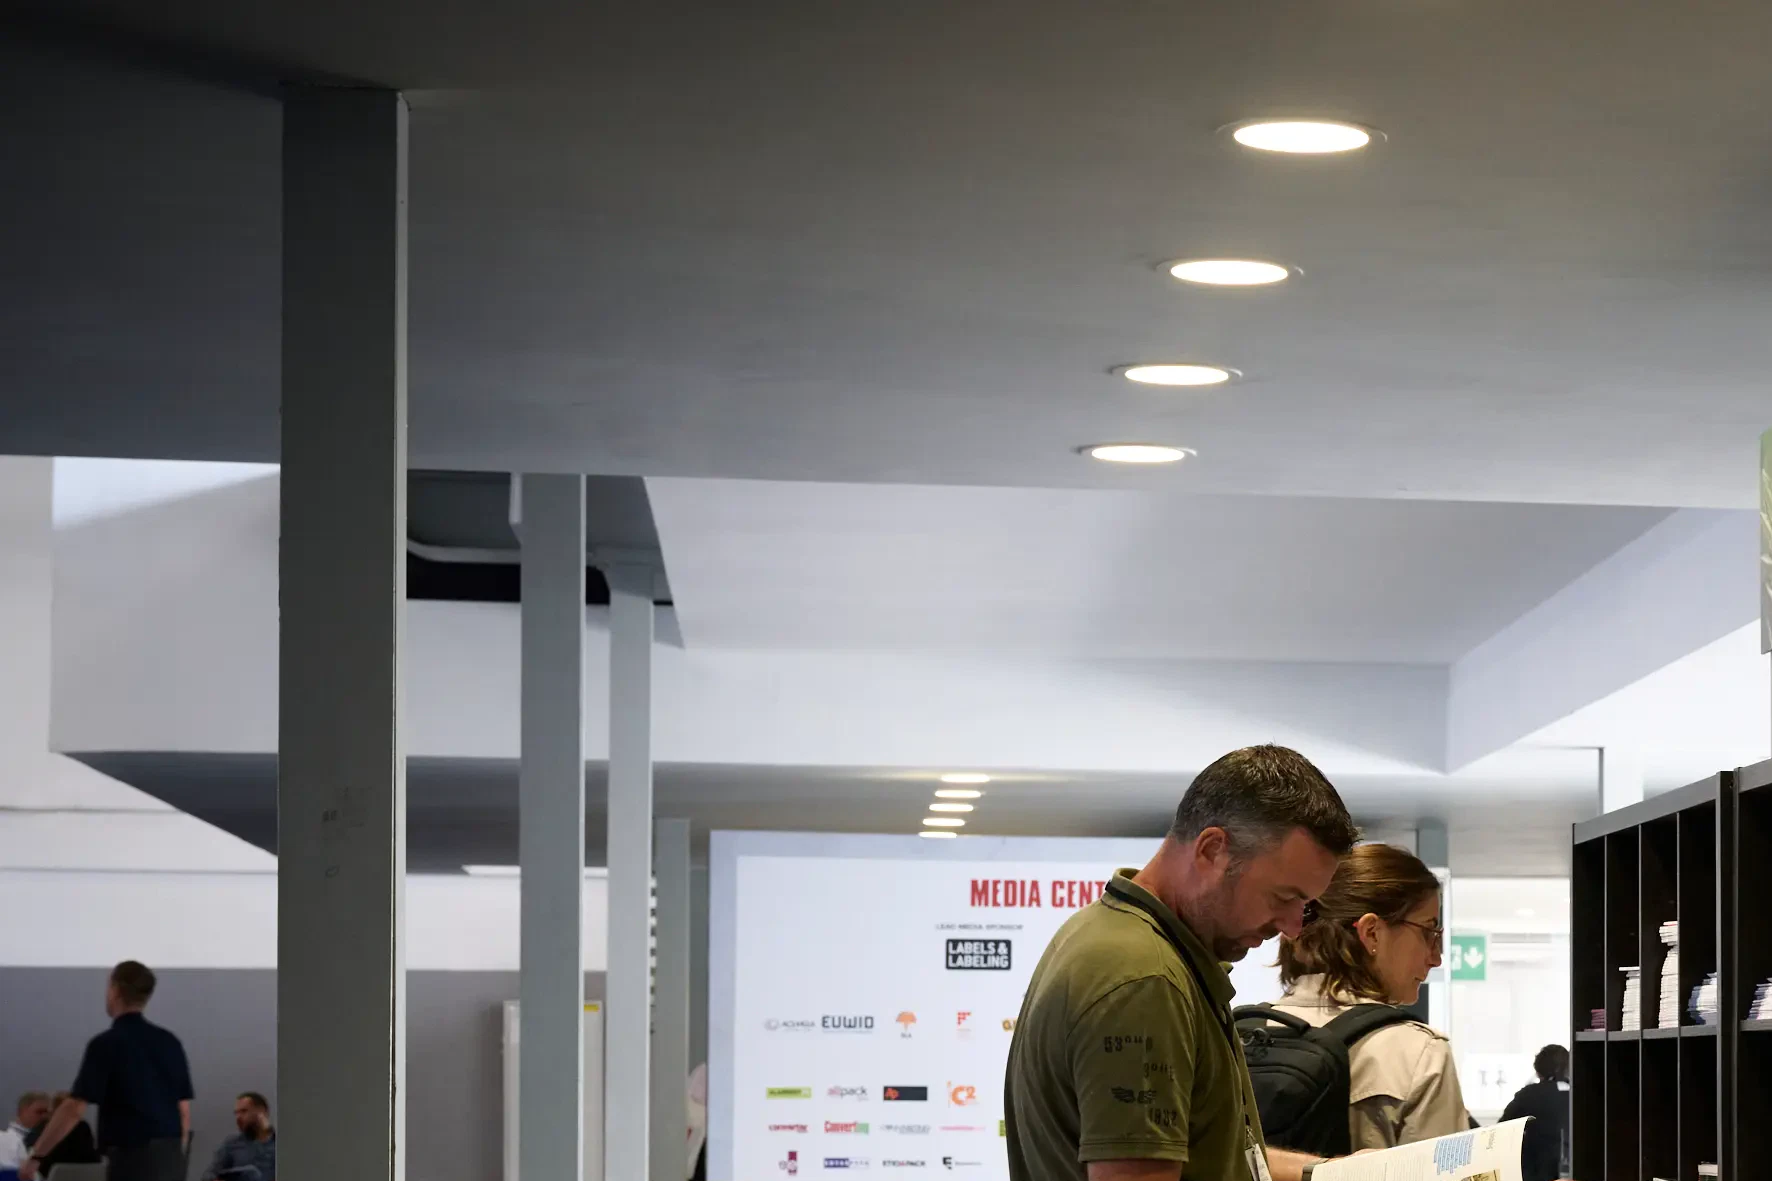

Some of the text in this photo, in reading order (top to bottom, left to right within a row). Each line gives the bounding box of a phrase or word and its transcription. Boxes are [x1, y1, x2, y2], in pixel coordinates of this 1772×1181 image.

[970, 879, 1106, 909] MEDIA CENT
[958, 923, 983, 931] MEDIA
[985, 923, 1024, 931] SPONSOR
[948, 941, 1009, 955] LABELS &
[948, 955, 1010, 969] LABELING
[821, 1014, 875, 1030] EUWID
